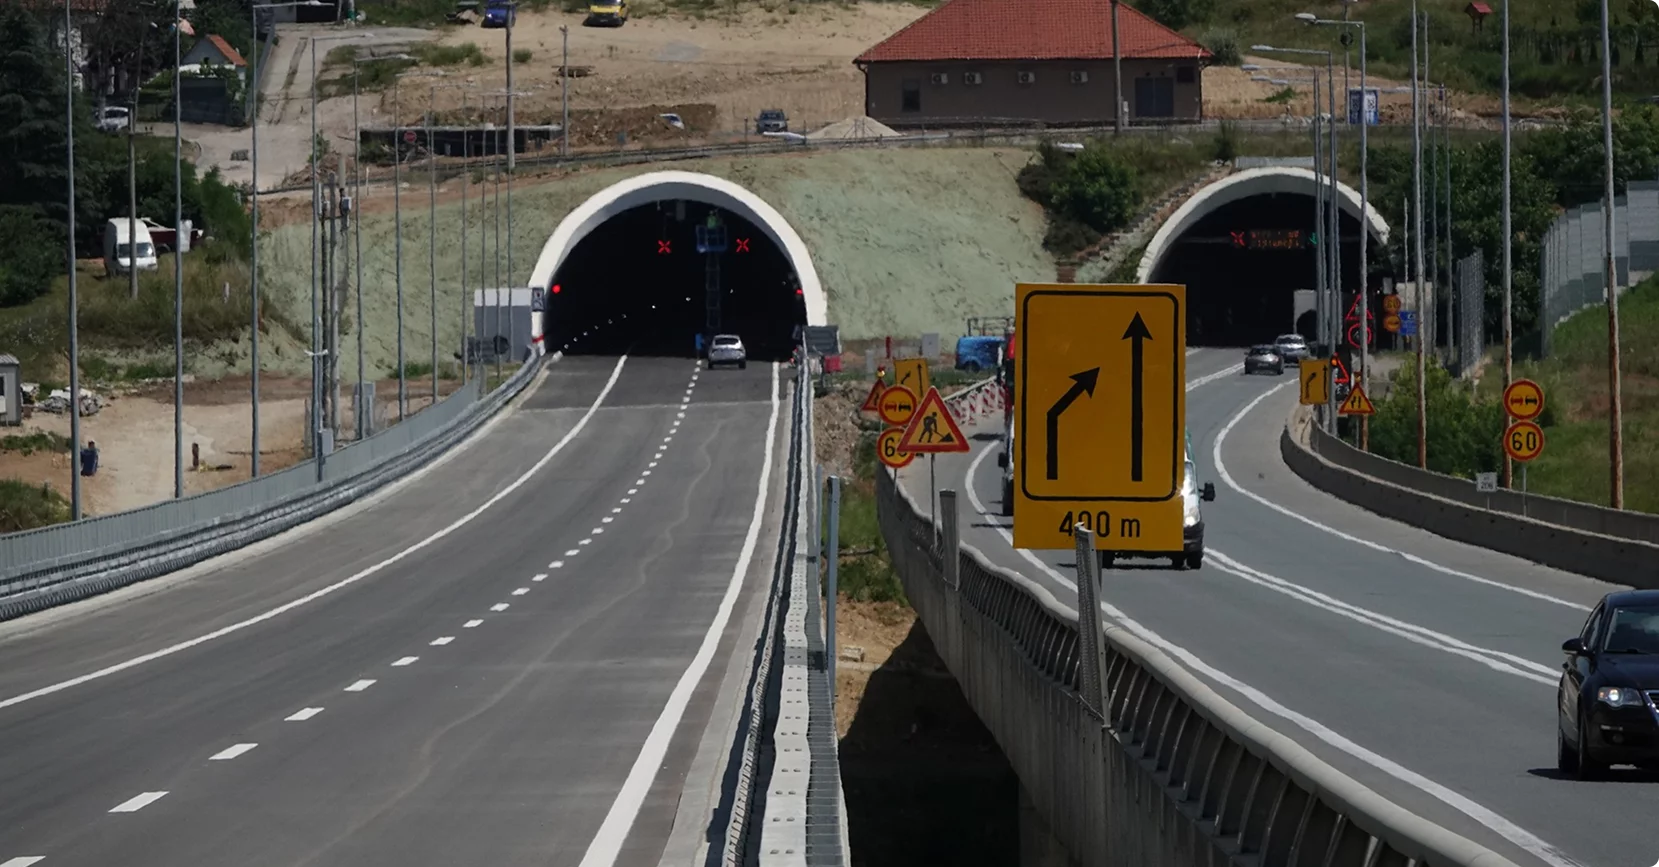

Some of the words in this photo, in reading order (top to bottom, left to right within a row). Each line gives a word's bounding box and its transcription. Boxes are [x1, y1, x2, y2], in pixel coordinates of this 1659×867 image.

[884, 436, 907, 457] 6
[1512, 431, 1536, 451] 60
[1059, 511, 1110, 538] 400
[1121, 518, 1140, 538] m
